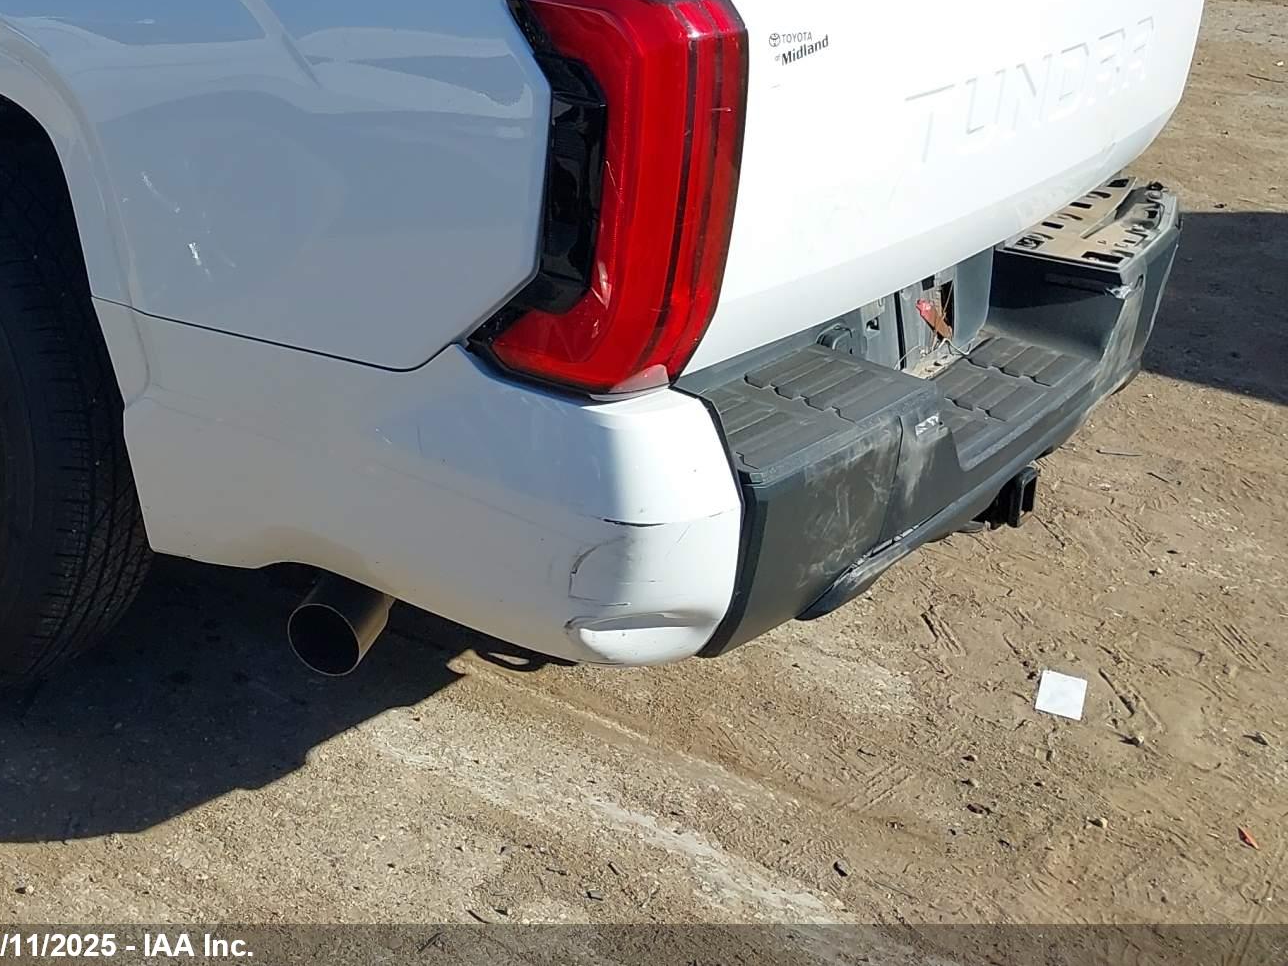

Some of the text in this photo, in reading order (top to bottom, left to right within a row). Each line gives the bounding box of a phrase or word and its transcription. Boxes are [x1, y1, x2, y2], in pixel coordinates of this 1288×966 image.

[781, 31, 813, 44] TOYOTA
[781, 33, 829, 66] Midland
[905, 16, 1155, 164] TUNDRA
